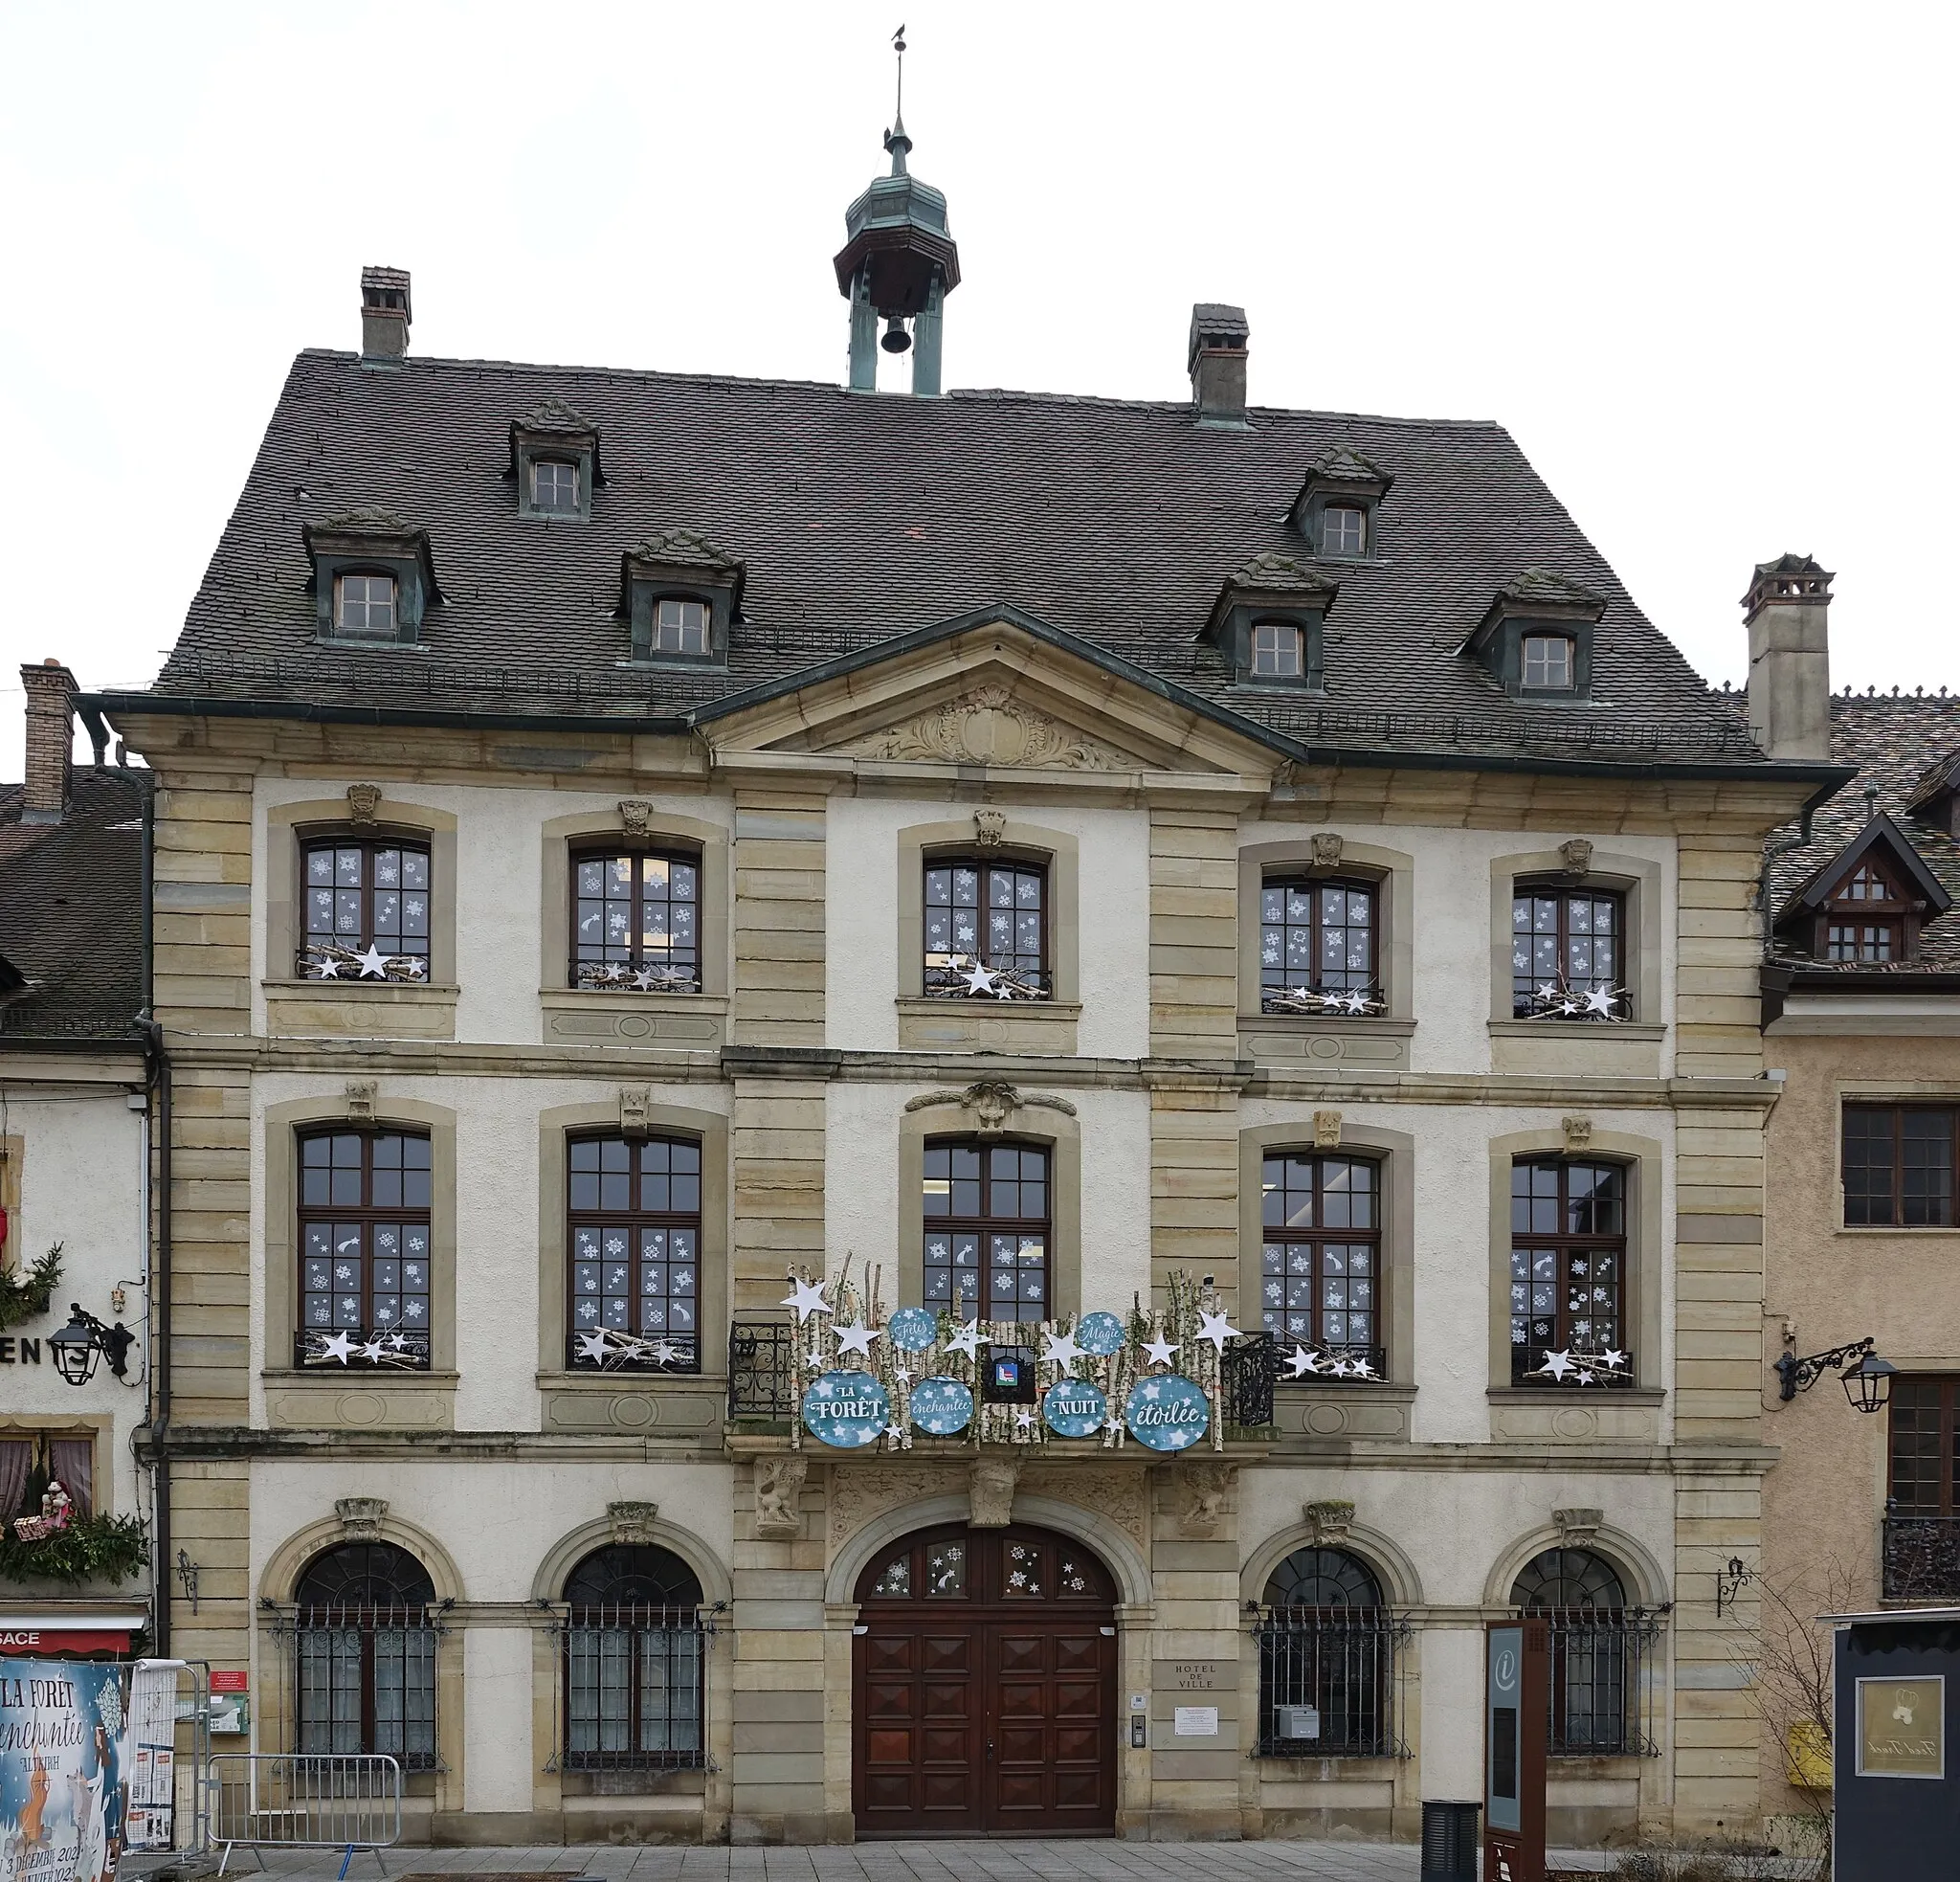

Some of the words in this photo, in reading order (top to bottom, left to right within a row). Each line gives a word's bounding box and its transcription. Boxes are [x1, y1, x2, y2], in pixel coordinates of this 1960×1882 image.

[1078, 1326, 1121, 1342] Magie
[835, 1387, 856, 1398] LA
[810, 1396, 883, 1419] FORÊT
[912, 1399, 970, 1414] enchantée
[1051, 1400, 1100, 1415] NUIT
[1136, 1400, 1201, 1425] étoilée
[1175, 1665, 1216, 1673] HOTEL
[1, 1678, 25, 1708] LA
[29, 1672, 75, 1708] FORÊT
[1179, 1680, 1214, 1689] VILLE
[7, 1857, 13, 1874] 3
